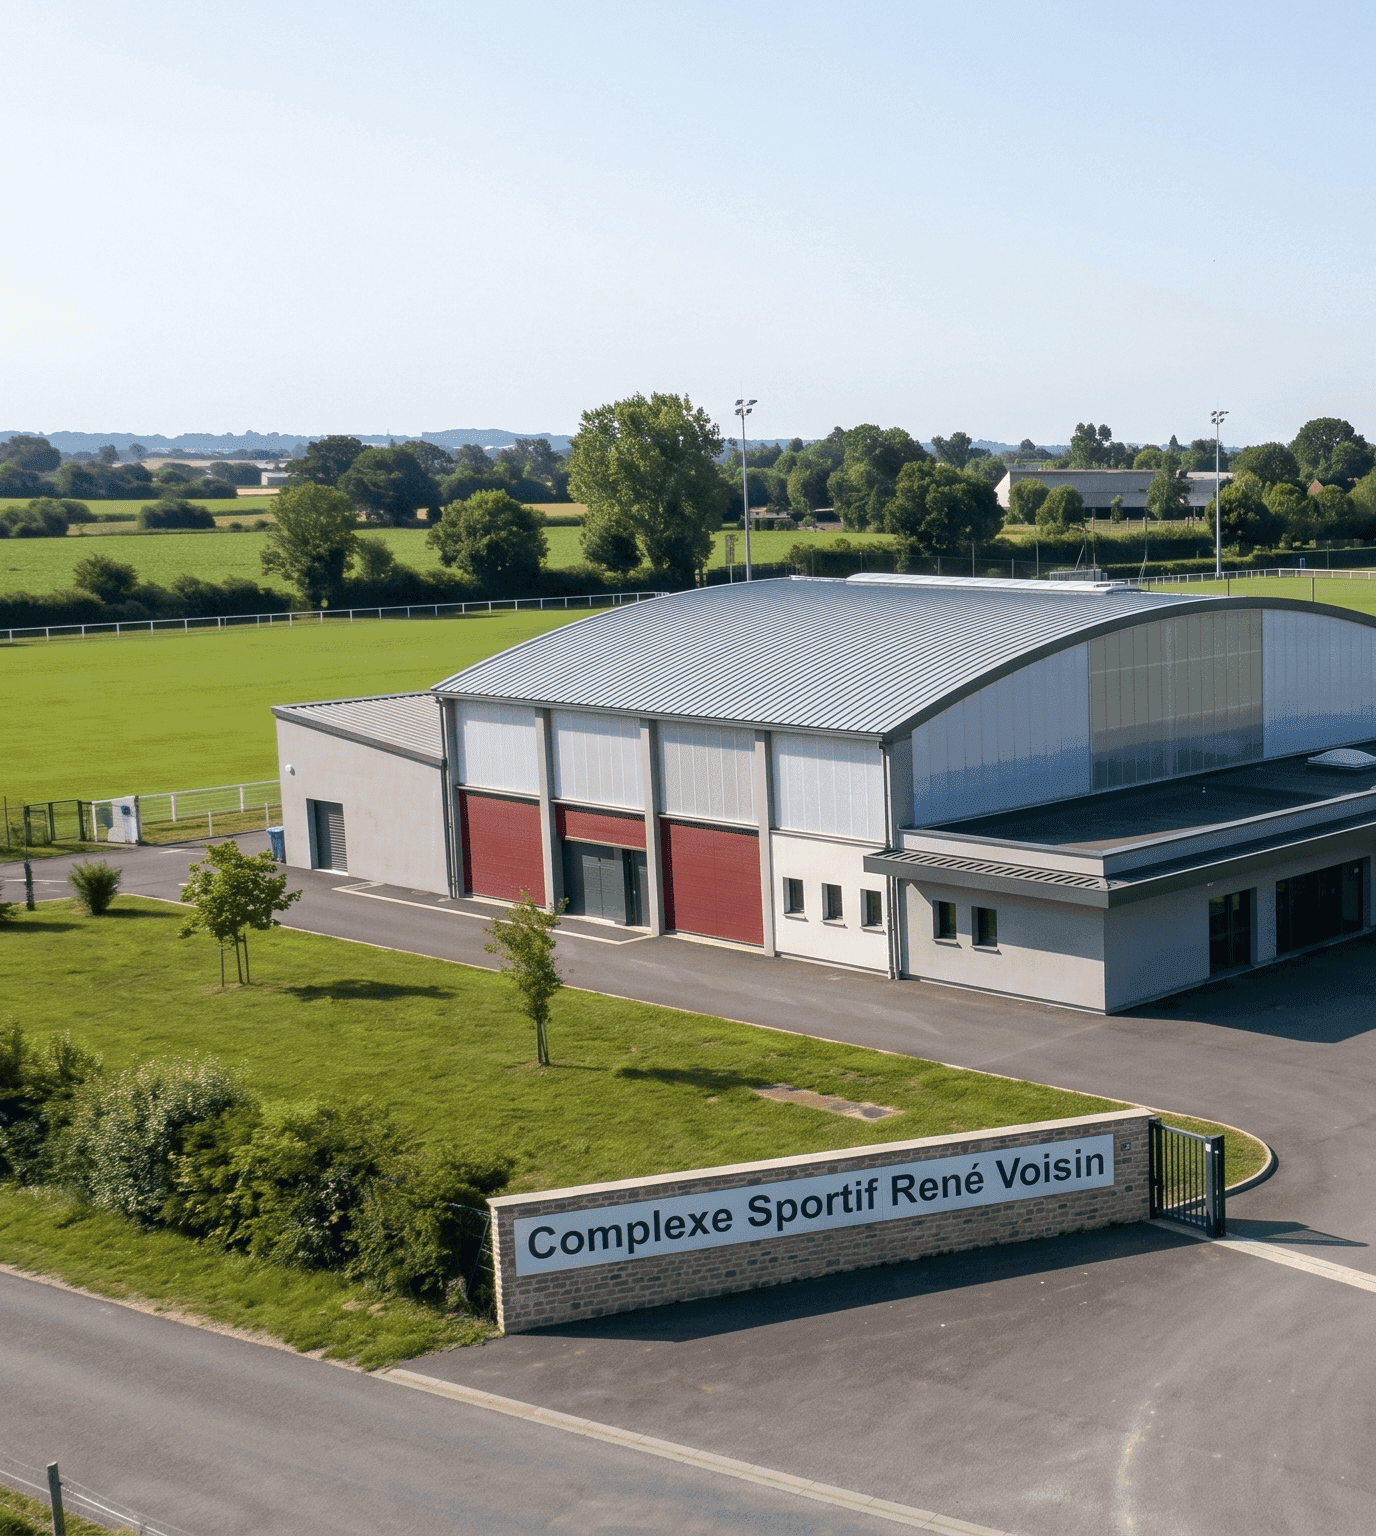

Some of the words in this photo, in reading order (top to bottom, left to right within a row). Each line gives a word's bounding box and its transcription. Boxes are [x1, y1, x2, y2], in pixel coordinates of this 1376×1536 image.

[528, 1208, 733, 1260] Complexe
[747, 1177, 879, 1233] Sportif
[891, 1162, 985, 1207] René
[995, 1148, 1105, 1190] Voisin
